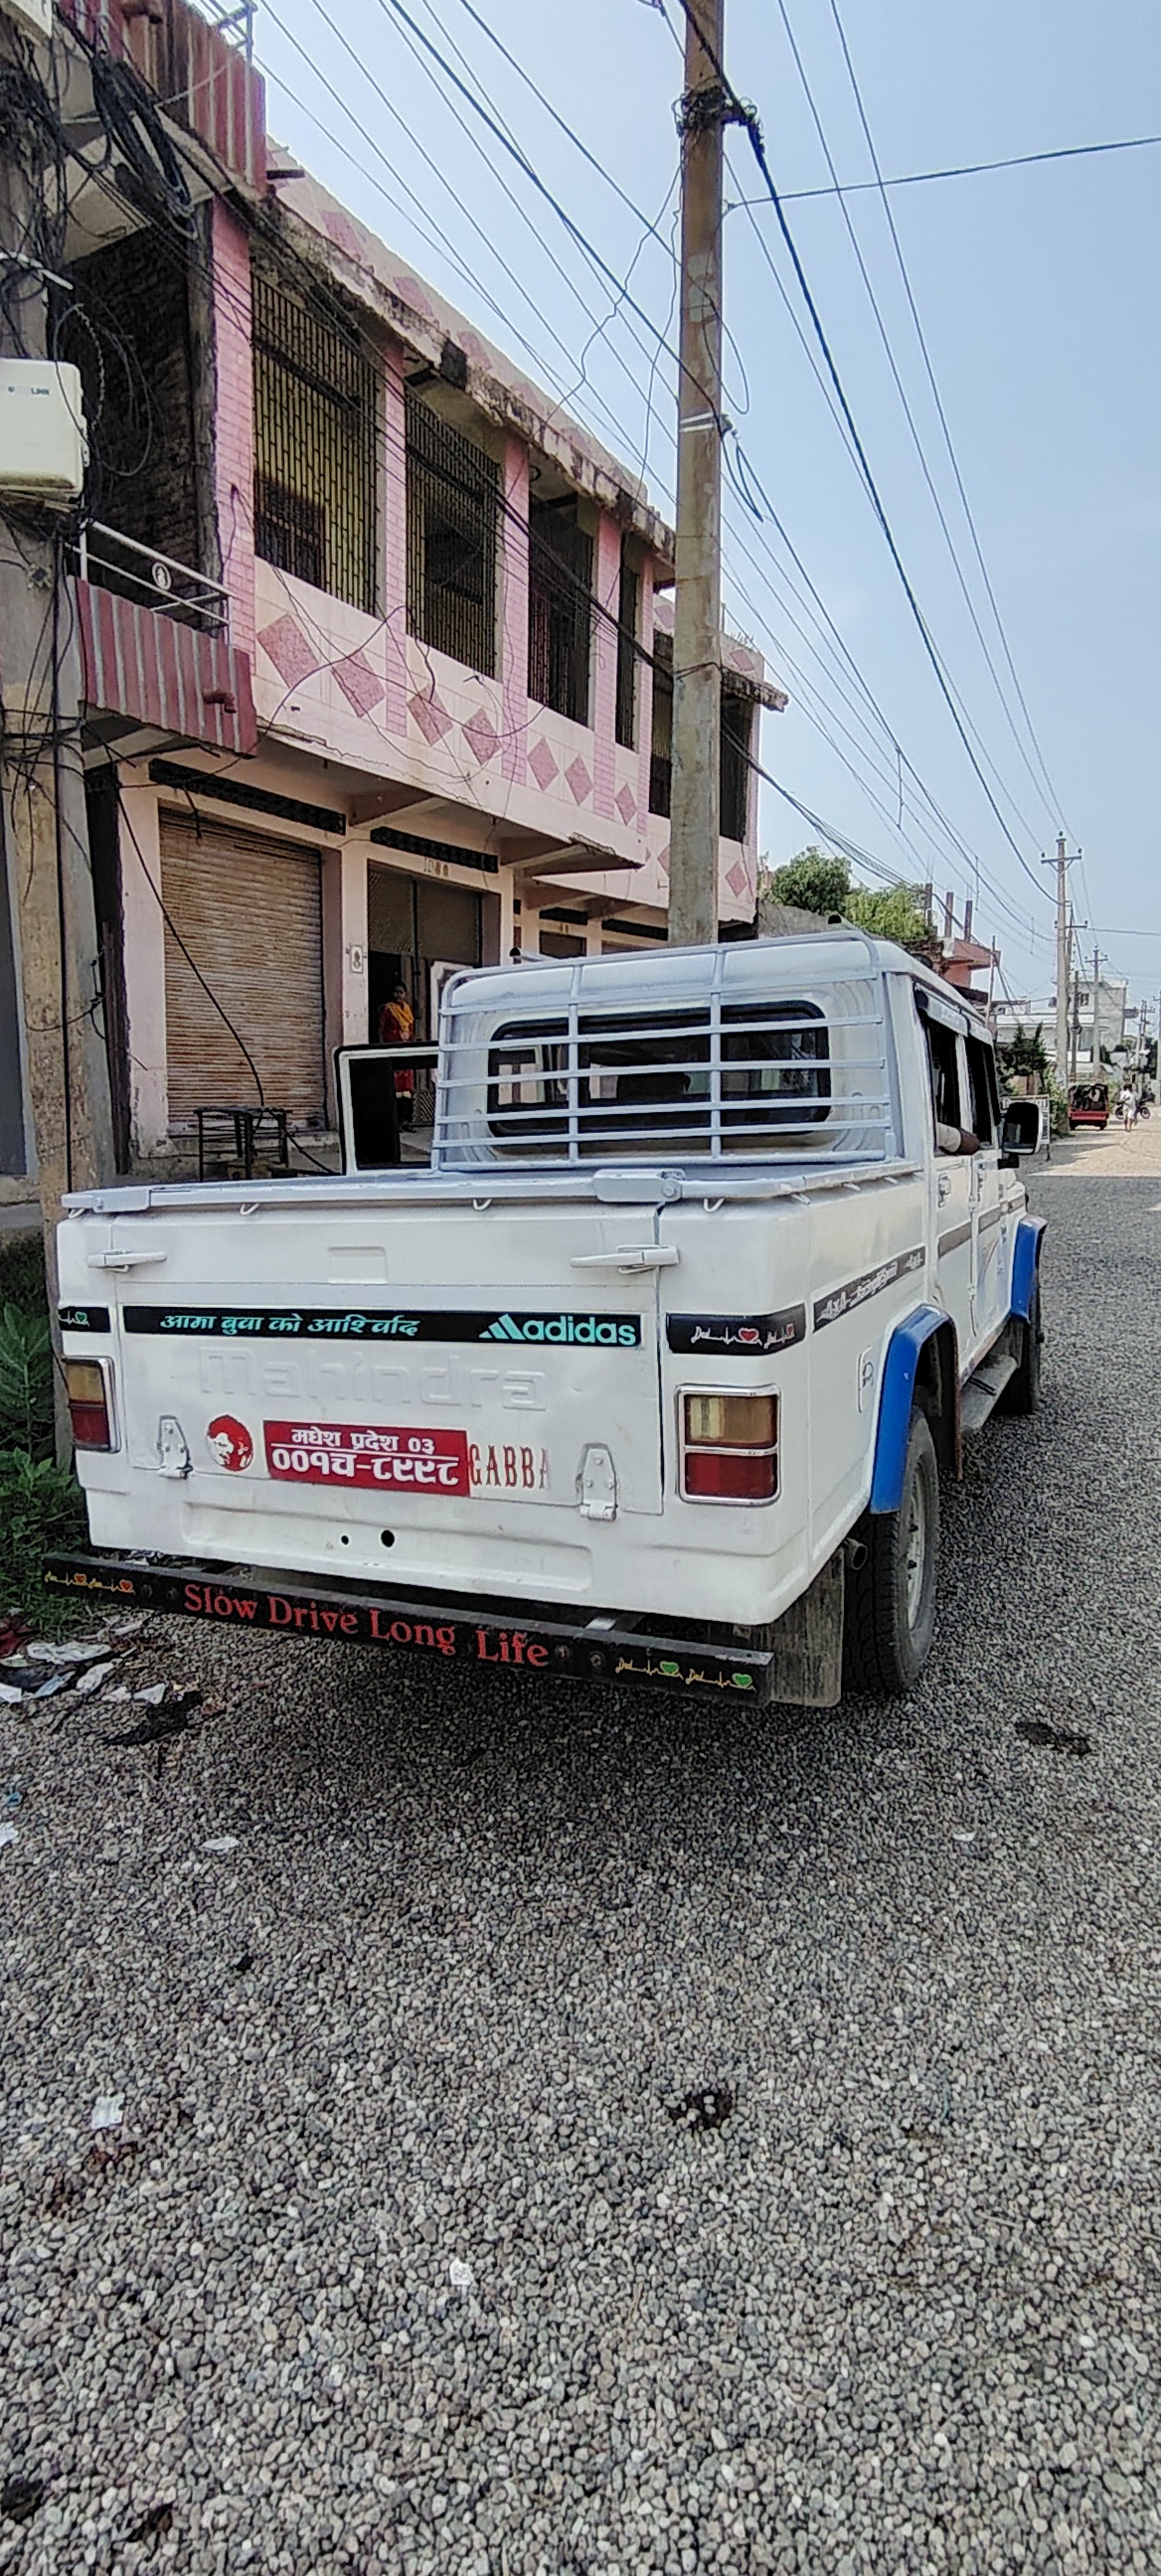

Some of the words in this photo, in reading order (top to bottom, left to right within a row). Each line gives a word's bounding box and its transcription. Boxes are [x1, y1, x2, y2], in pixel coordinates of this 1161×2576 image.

[160, 1314, 217, 1330] आमा
[221, 1314, 264, 1336] बुवा
[268, 1313, 303, 1333] को
[522, 1315, 636, 1346] adidas
[351, 1430, 400, 1452] प्रदेश
[184, 1584, 257, 1619] Slow
[267, 1596, 359, 1634] Drive
[369, 1608, 456, 1656] Long
[476, 1629, 550, 1667] Life
